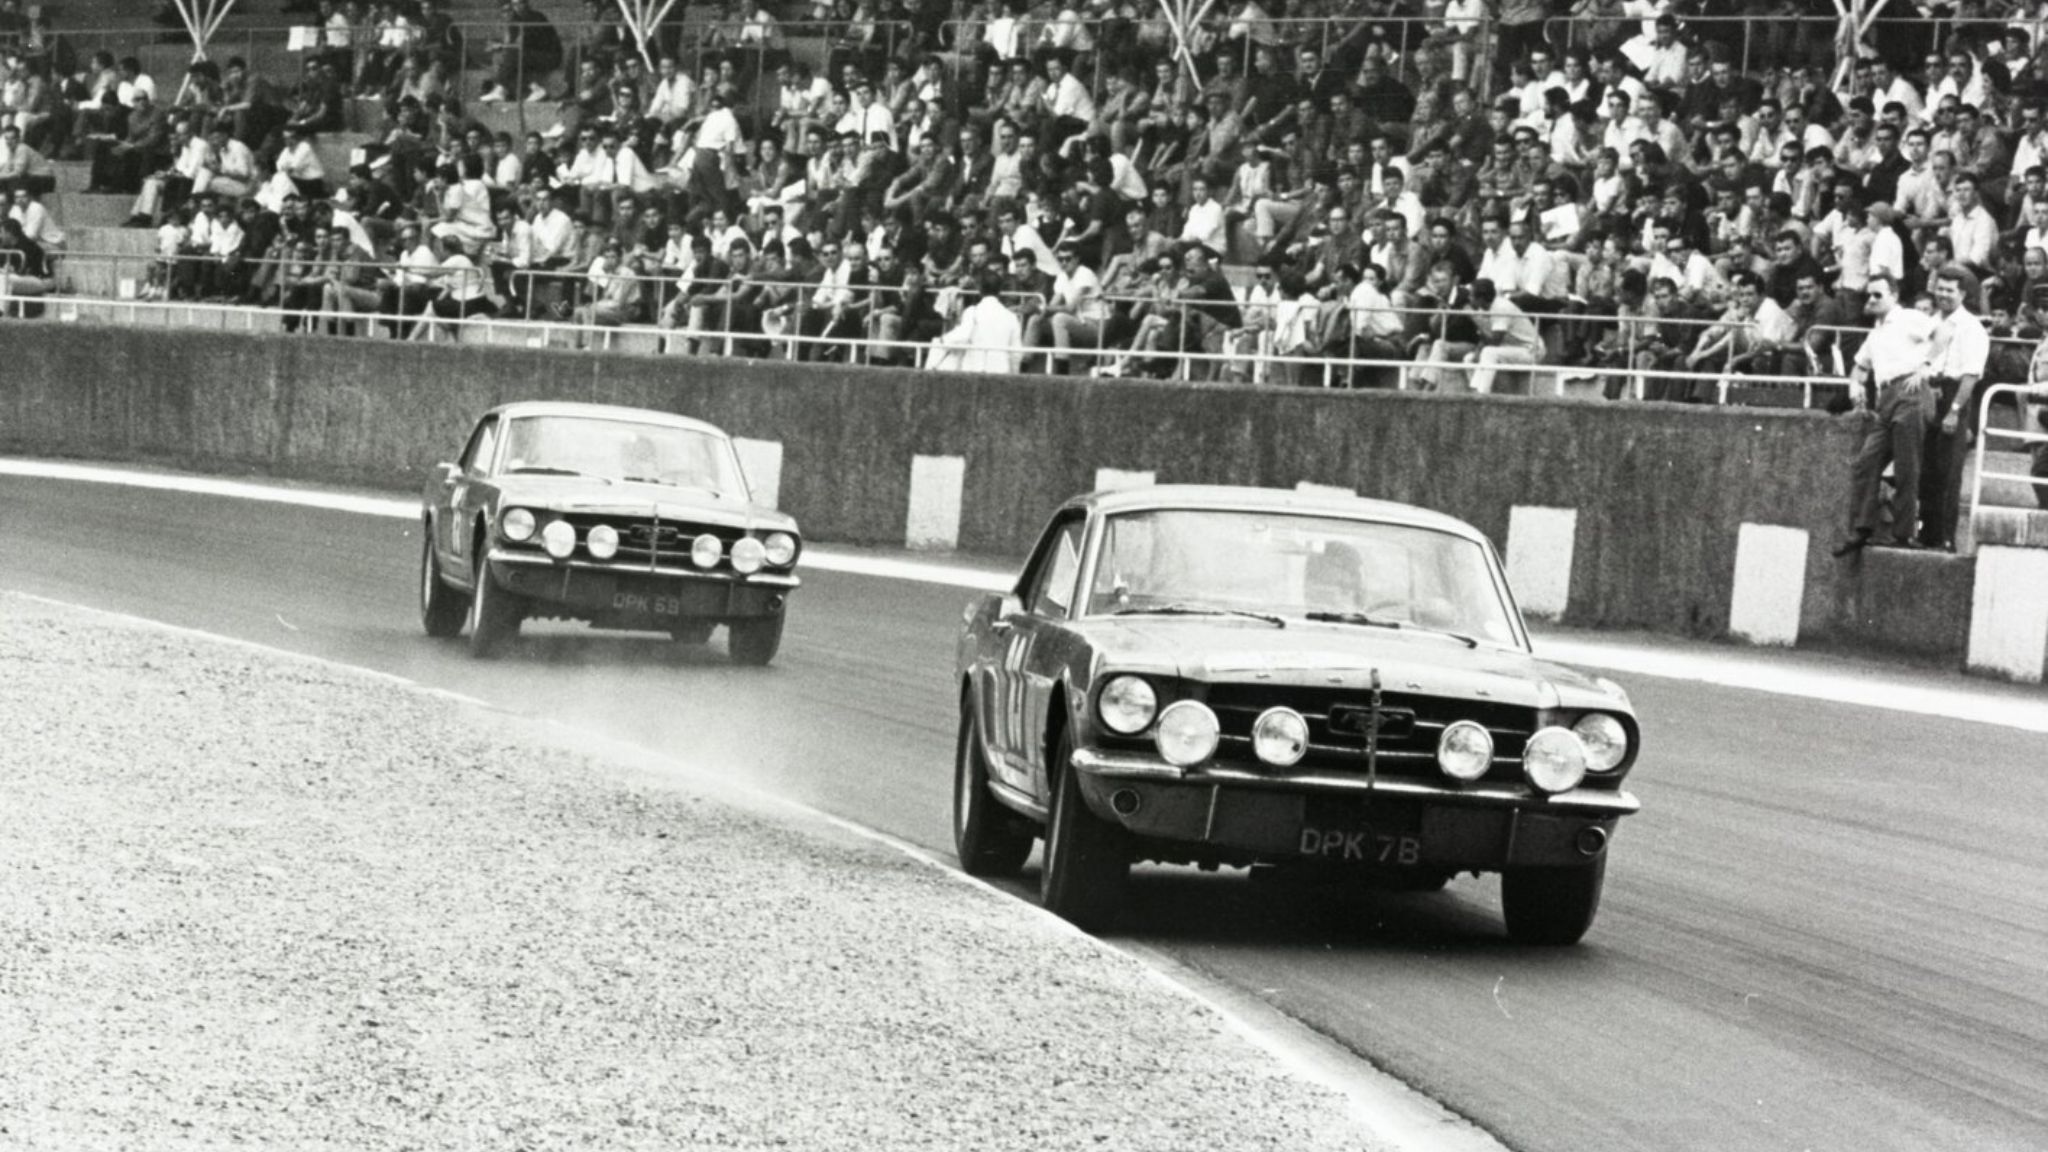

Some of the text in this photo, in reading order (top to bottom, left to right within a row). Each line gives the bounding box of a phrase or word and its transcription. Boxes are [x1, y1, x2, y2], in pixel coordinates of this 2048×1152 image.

[612, 593, 649, 613] DPK
[1300, 828, 1420, 865] DPK 7B
